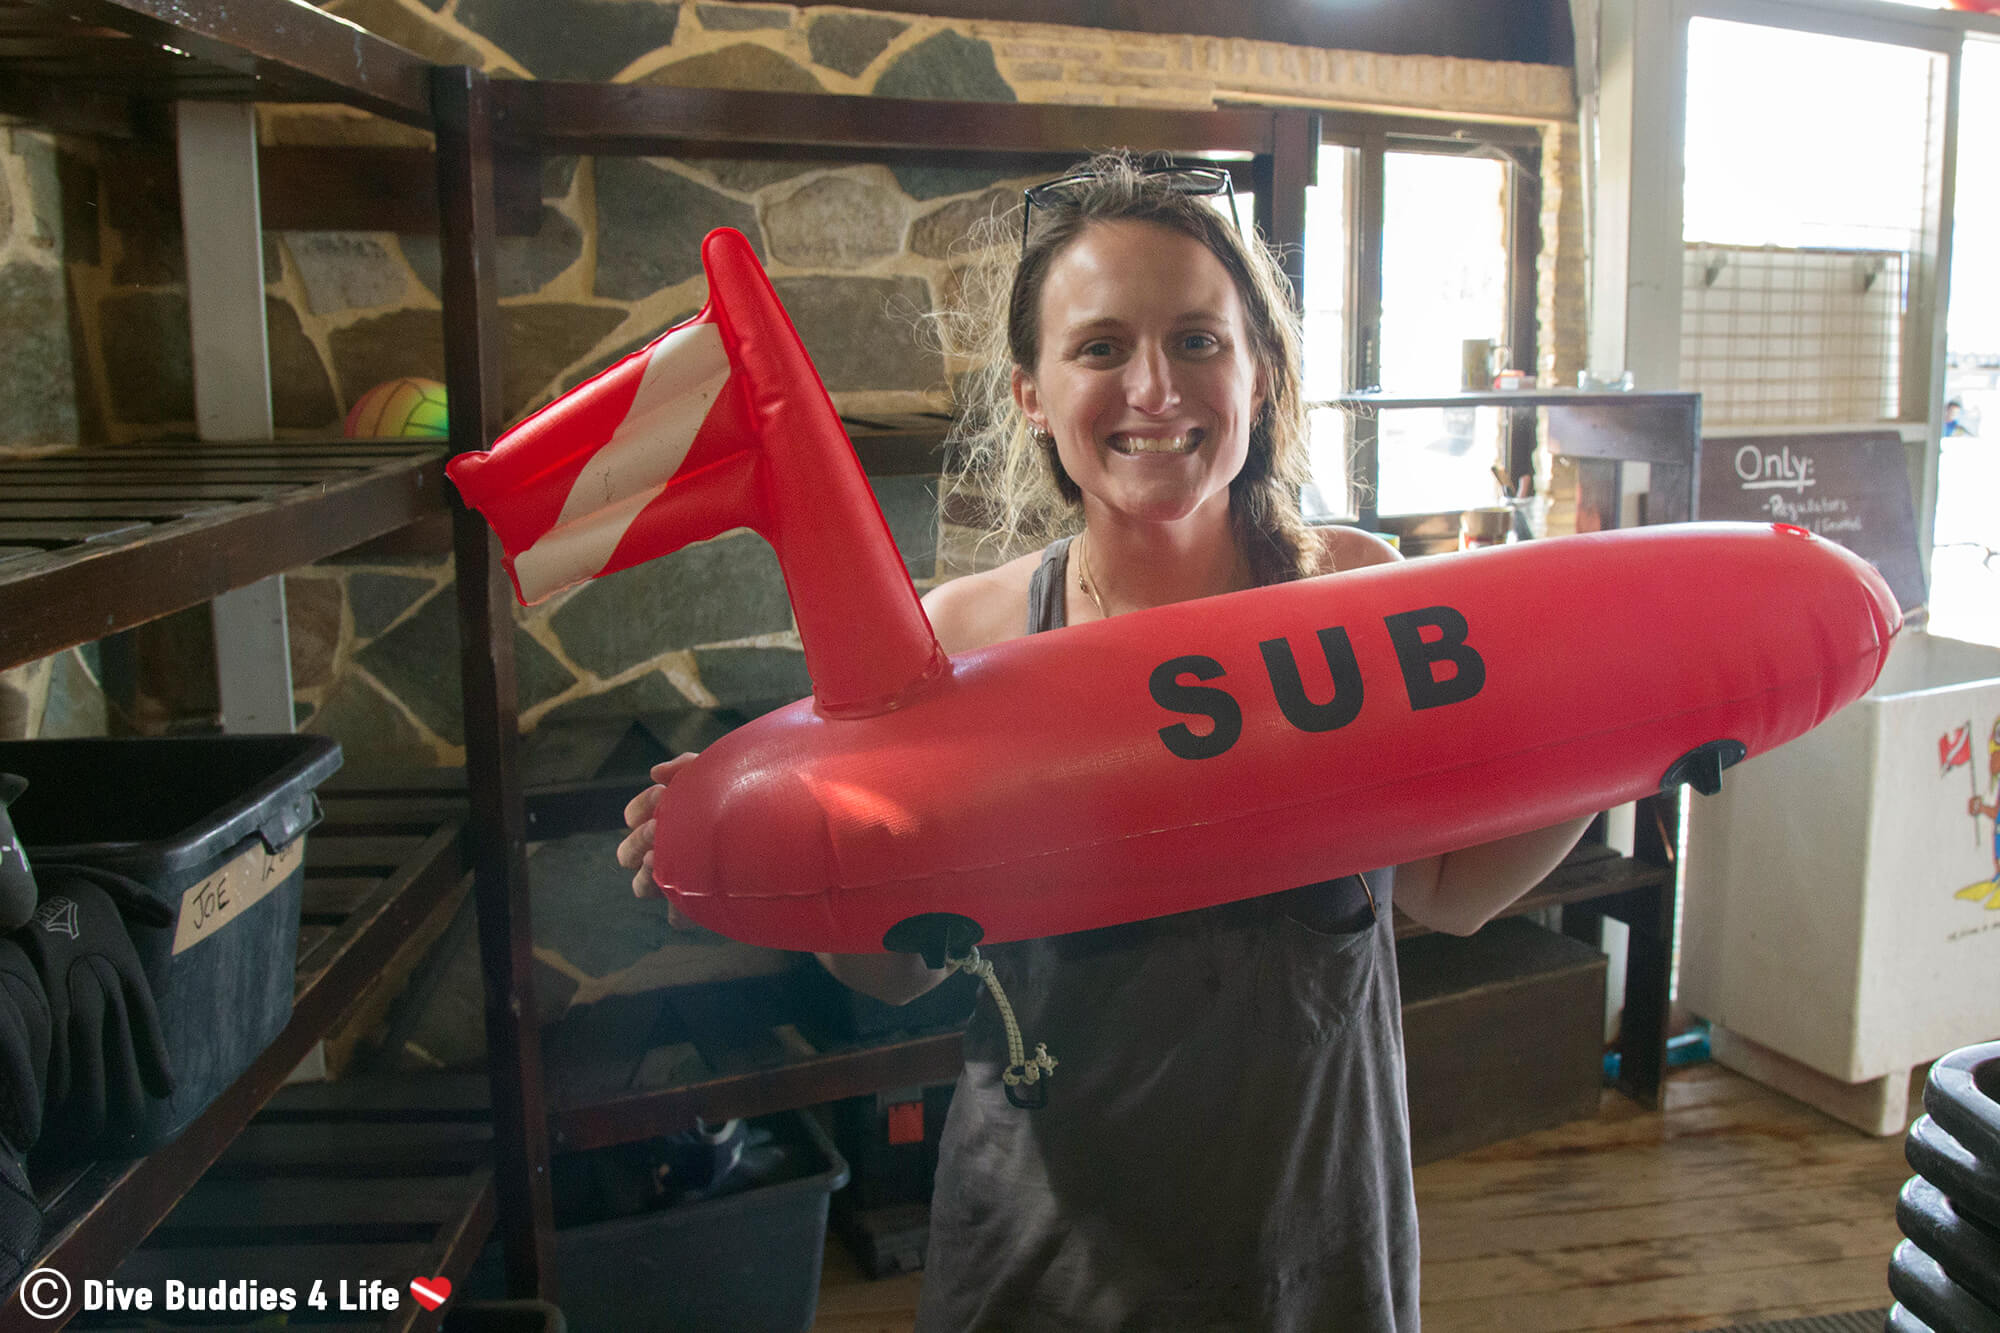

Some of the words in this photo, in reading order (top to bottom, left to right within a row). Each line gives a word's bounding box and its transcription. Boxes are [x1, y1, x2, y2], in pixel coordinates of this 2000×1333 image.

[1735, 445, 1814, 493] Only:
[1149, 605, 1486, 760] SUB
[193, 877, 231, 930] JOE
